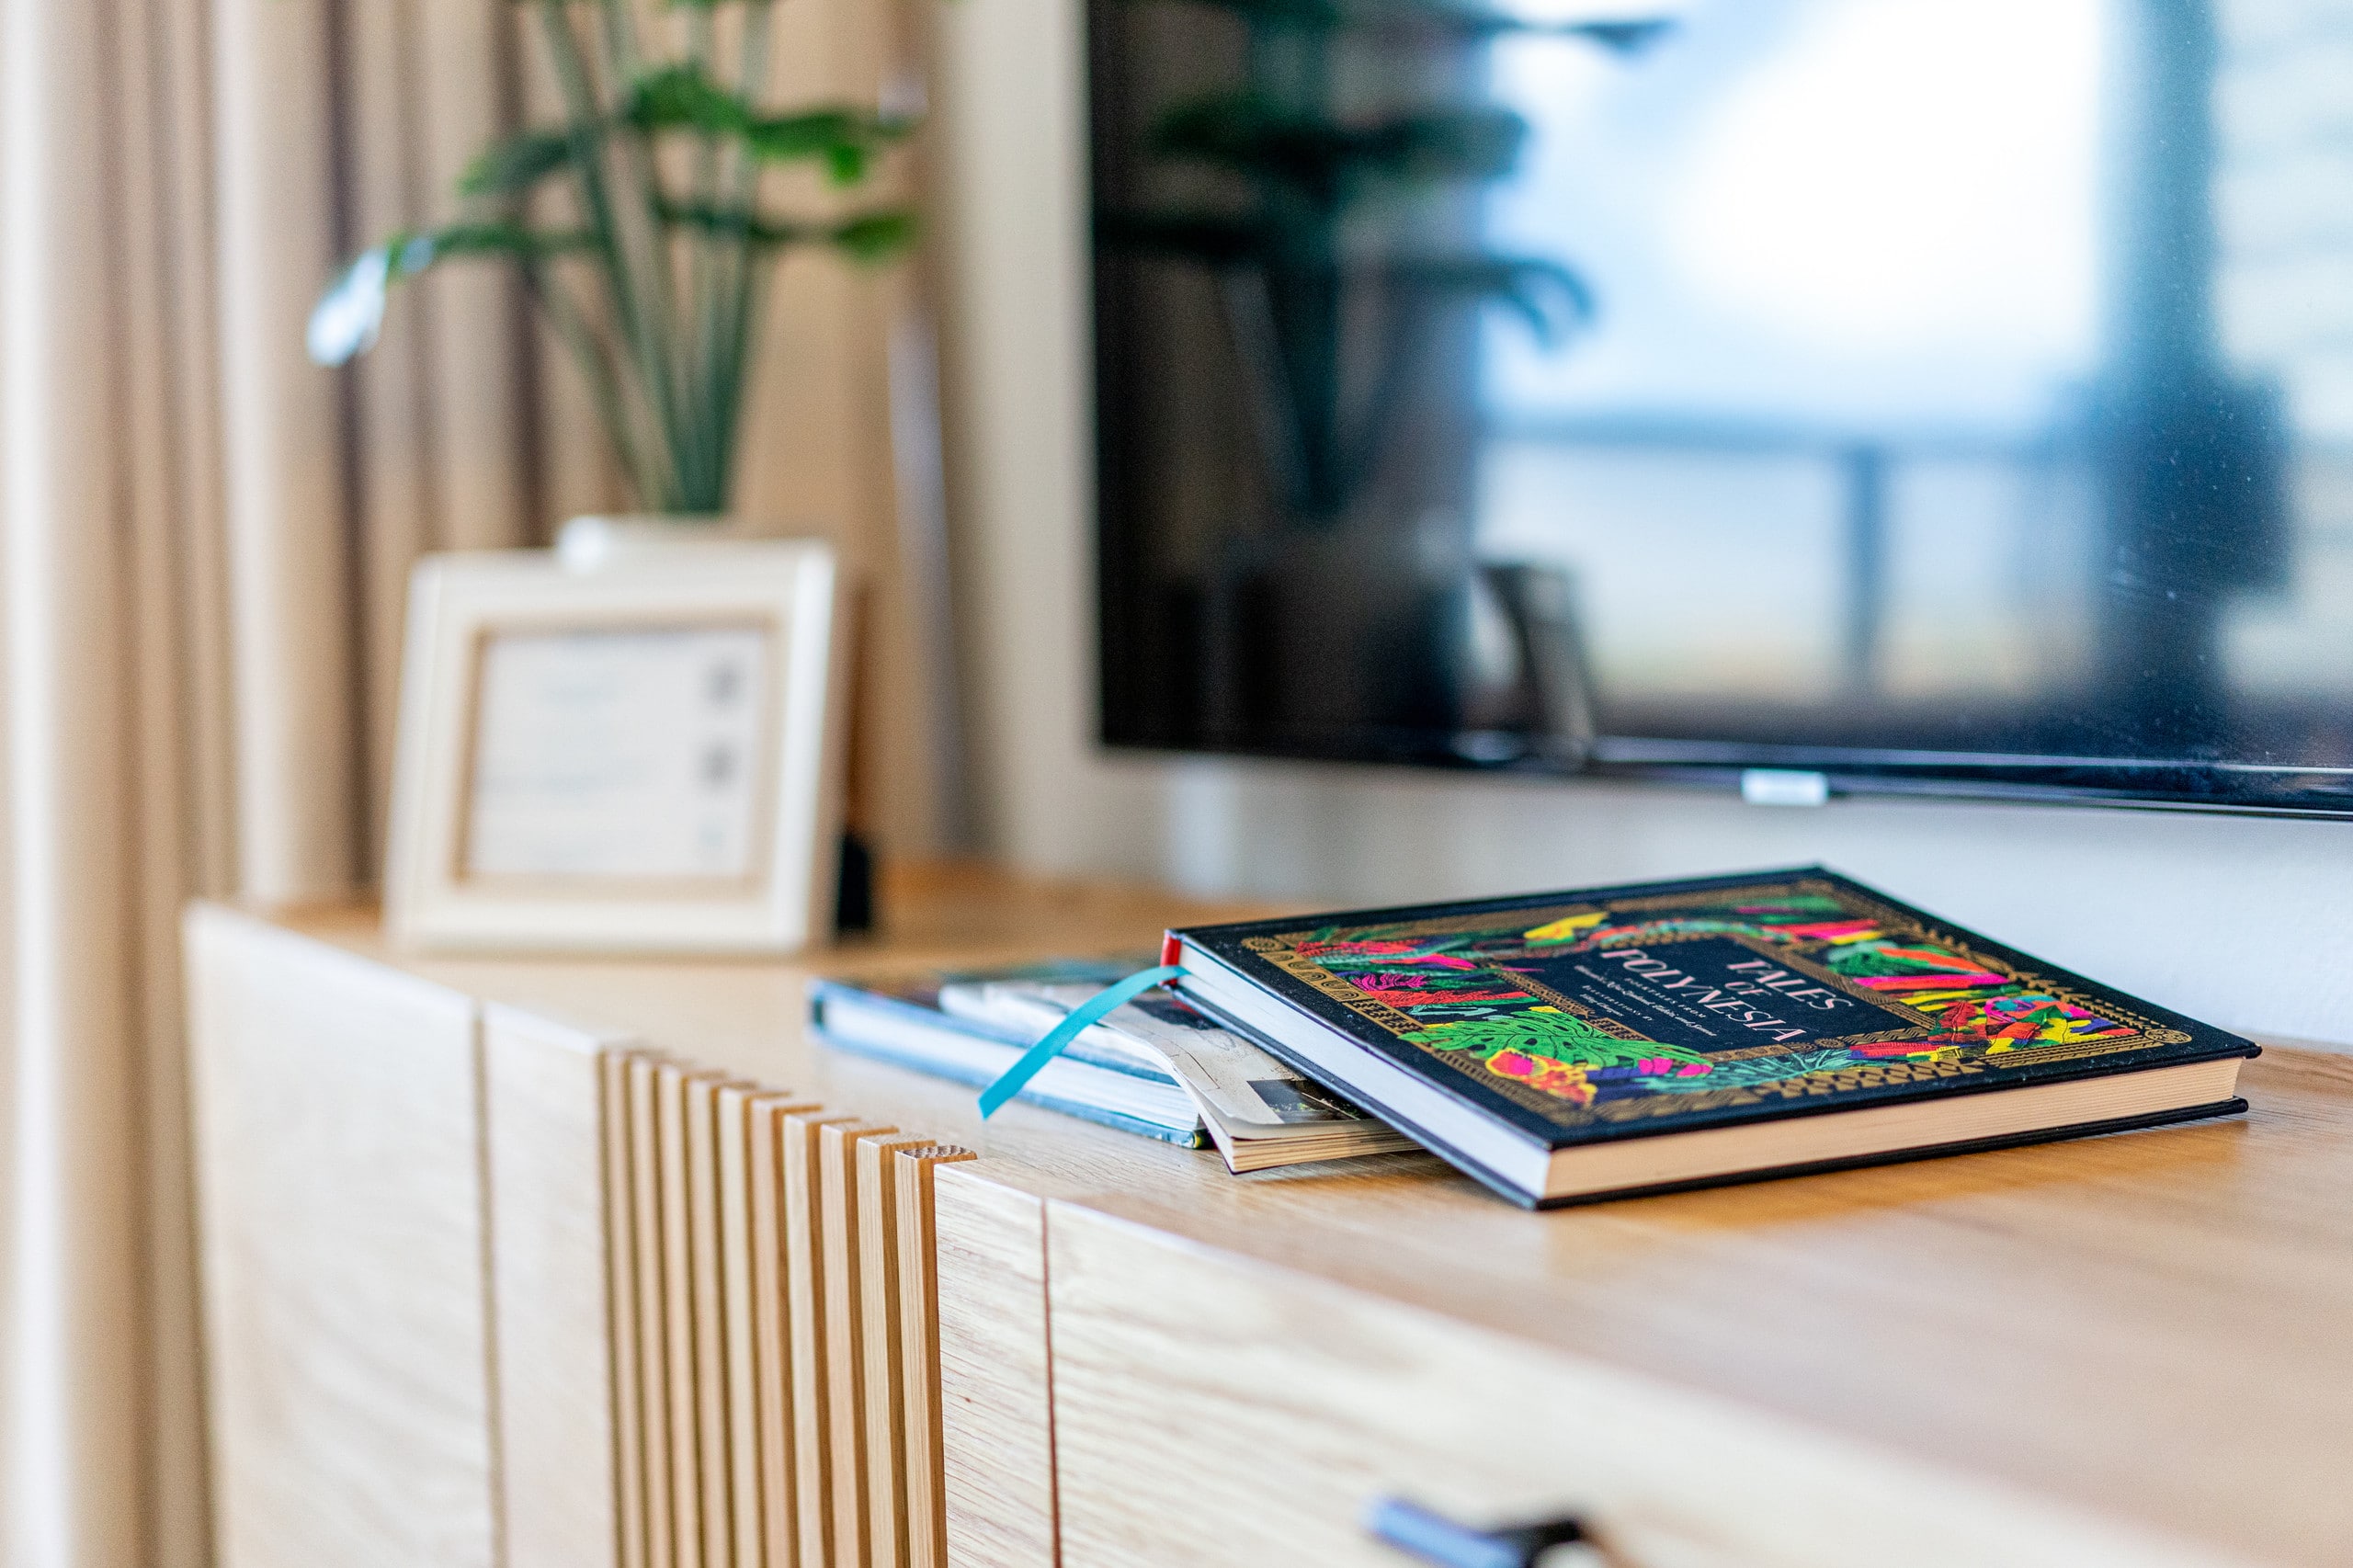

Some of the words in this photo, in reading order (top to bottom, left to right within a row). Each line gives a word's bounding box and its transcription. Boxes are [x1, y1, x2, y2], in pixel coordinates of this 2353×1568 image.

[1600, 948, 1807, 1042] POLYNESIA
[1724, 982, 1773, 996] OF
[1726, 959, 1855, 1010] TALES
[1677, 1004, 1707, 1018] FROM
